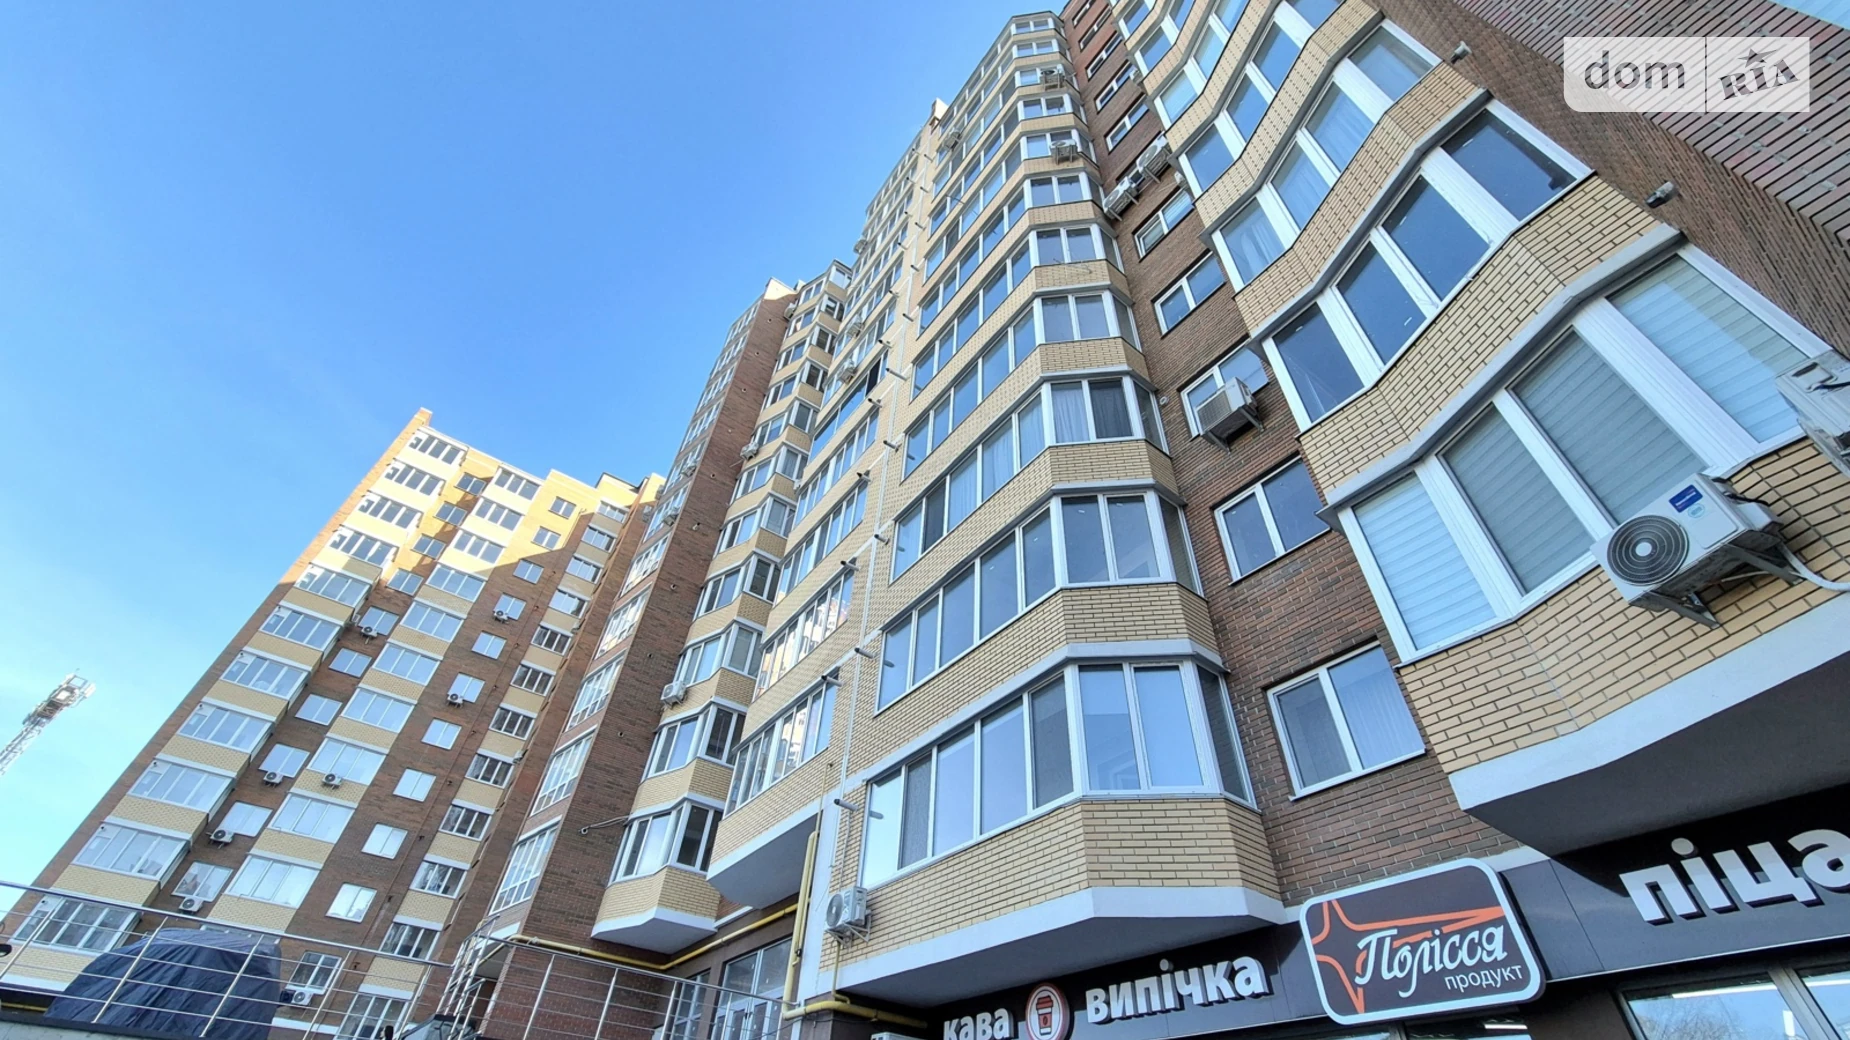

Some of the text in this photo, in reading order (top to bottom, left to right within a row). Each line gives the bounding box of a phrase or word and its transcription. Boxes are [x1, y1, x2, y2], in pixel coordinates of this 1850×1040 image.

[1619, 829, 1850, 921] піца
[943, 956, 1270, 1040] кава випічка
[1355, 925, 1507, 997] Полісся
[1444, 965, 1523, 993] продукт
